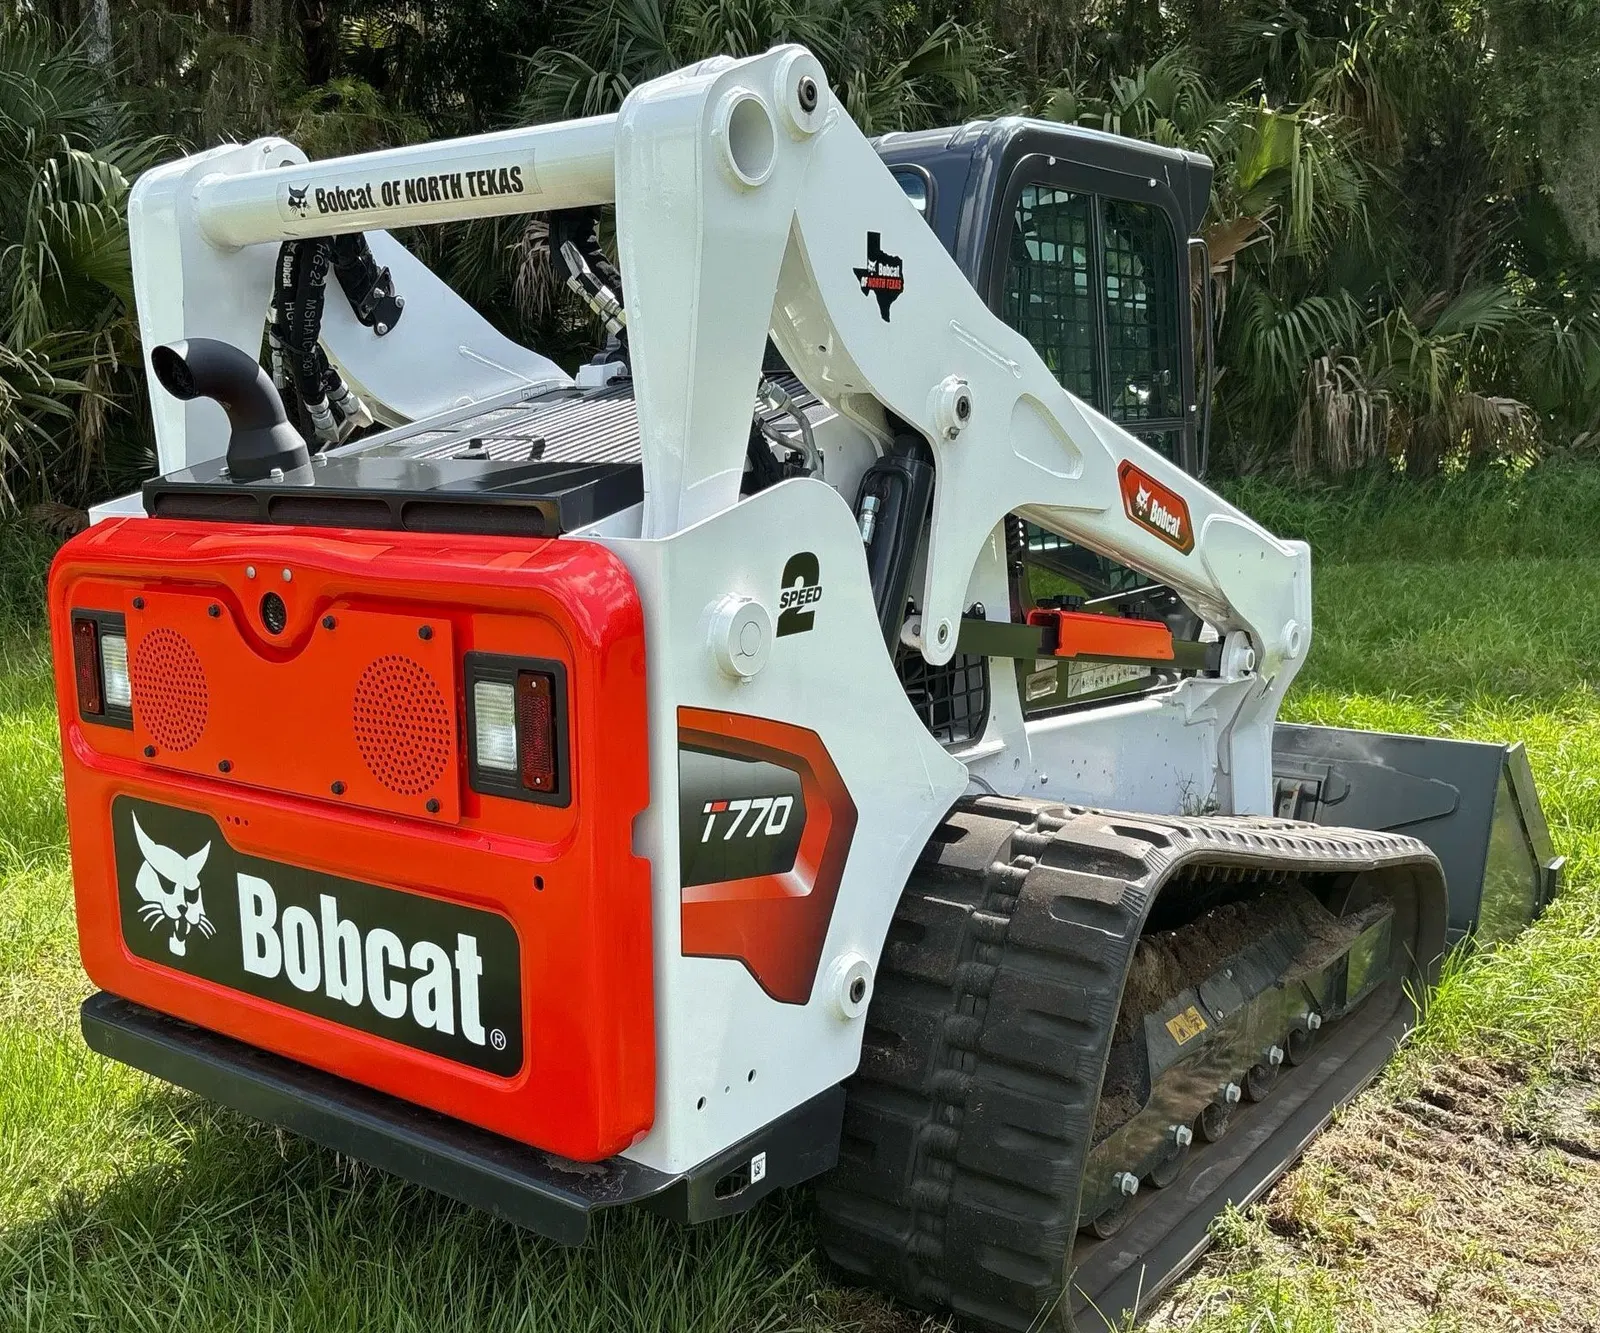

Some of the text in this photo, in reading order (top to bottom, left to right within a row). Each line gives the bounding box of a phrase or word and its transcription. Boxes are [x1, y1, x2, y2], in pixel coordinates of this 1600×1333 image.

[315, 166, 524, 214] Bobcat OF NORTH TEXAS
[282, 255, 294, 290] Bobcat
[868, 277, 886, 288] NORTH
[887, 279, 901, 290] TEXAS
[878, 263, 900, 277] Bobcat
[1150, 498, 1181, 539] Bobcat
[776, 551, 820, 637] 2
[779, 585, 823, 609] SPEED
